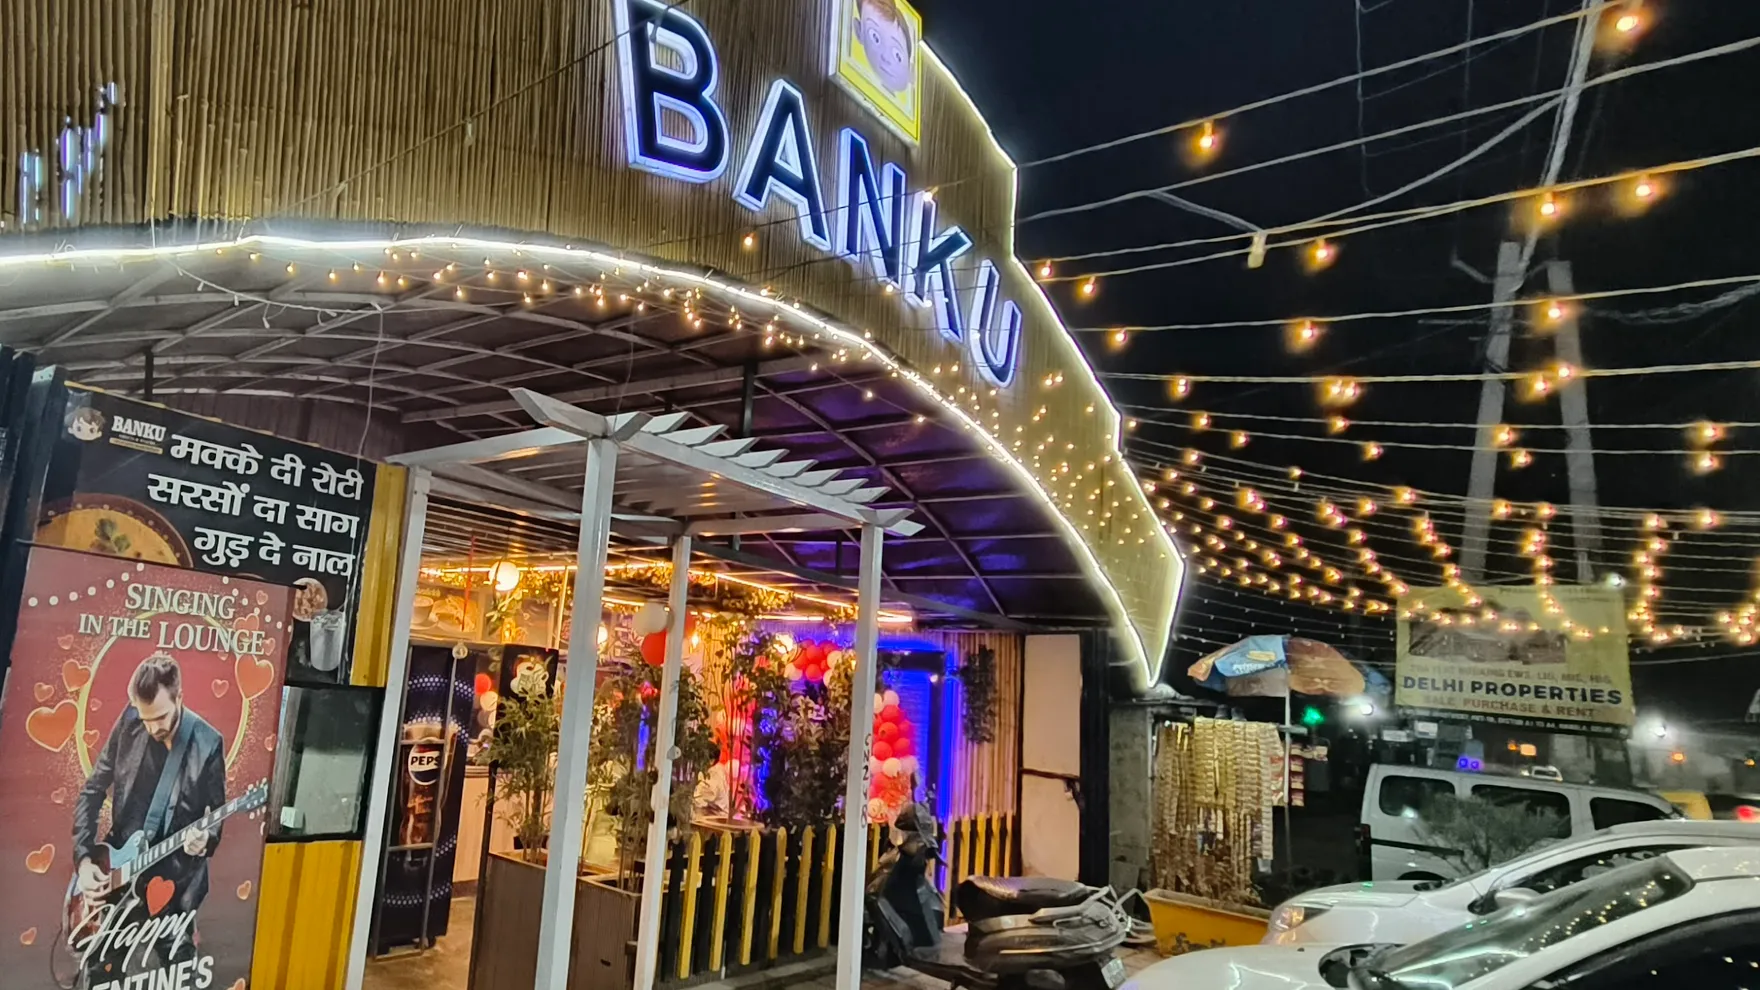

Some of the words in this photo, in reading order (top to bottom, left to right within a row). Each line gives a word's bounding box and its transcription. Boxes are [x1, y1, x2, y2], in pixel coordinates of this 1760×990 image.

[613, 0, 1022, 387] BANKU
[111, 415, 167, 442] BANKU
[170, 434, 263, 475] मक्के
[270, 453, 306, 487] दी
[311, 462, 364, 500] रोटी
[147, 473, 250, 516] सरसों
[253, 495, 290, 524] दा
[296, 504, 360, 539] साग
[194, 526, 254, 567] गुड़
[259, 531, 286, 565] दे
[292, 544, 355, 577] नाल
[124, 582, 236, 619] SINGING
[78, 613, 104, 634] IN
[109, 616, 151, 639] THE
[156, 621, 266, 655] LOUNGE
[1403, 676, 1464, 693] DELHI
[1471, 681, 1622, 705] PROPERTIES
[1463, 698, 1536, 713] PURCHASE
[1541, 703, 1551, 715] &
[1556, 706, 1595, 718] RENT
[68, 897, 197, 972] Happy
